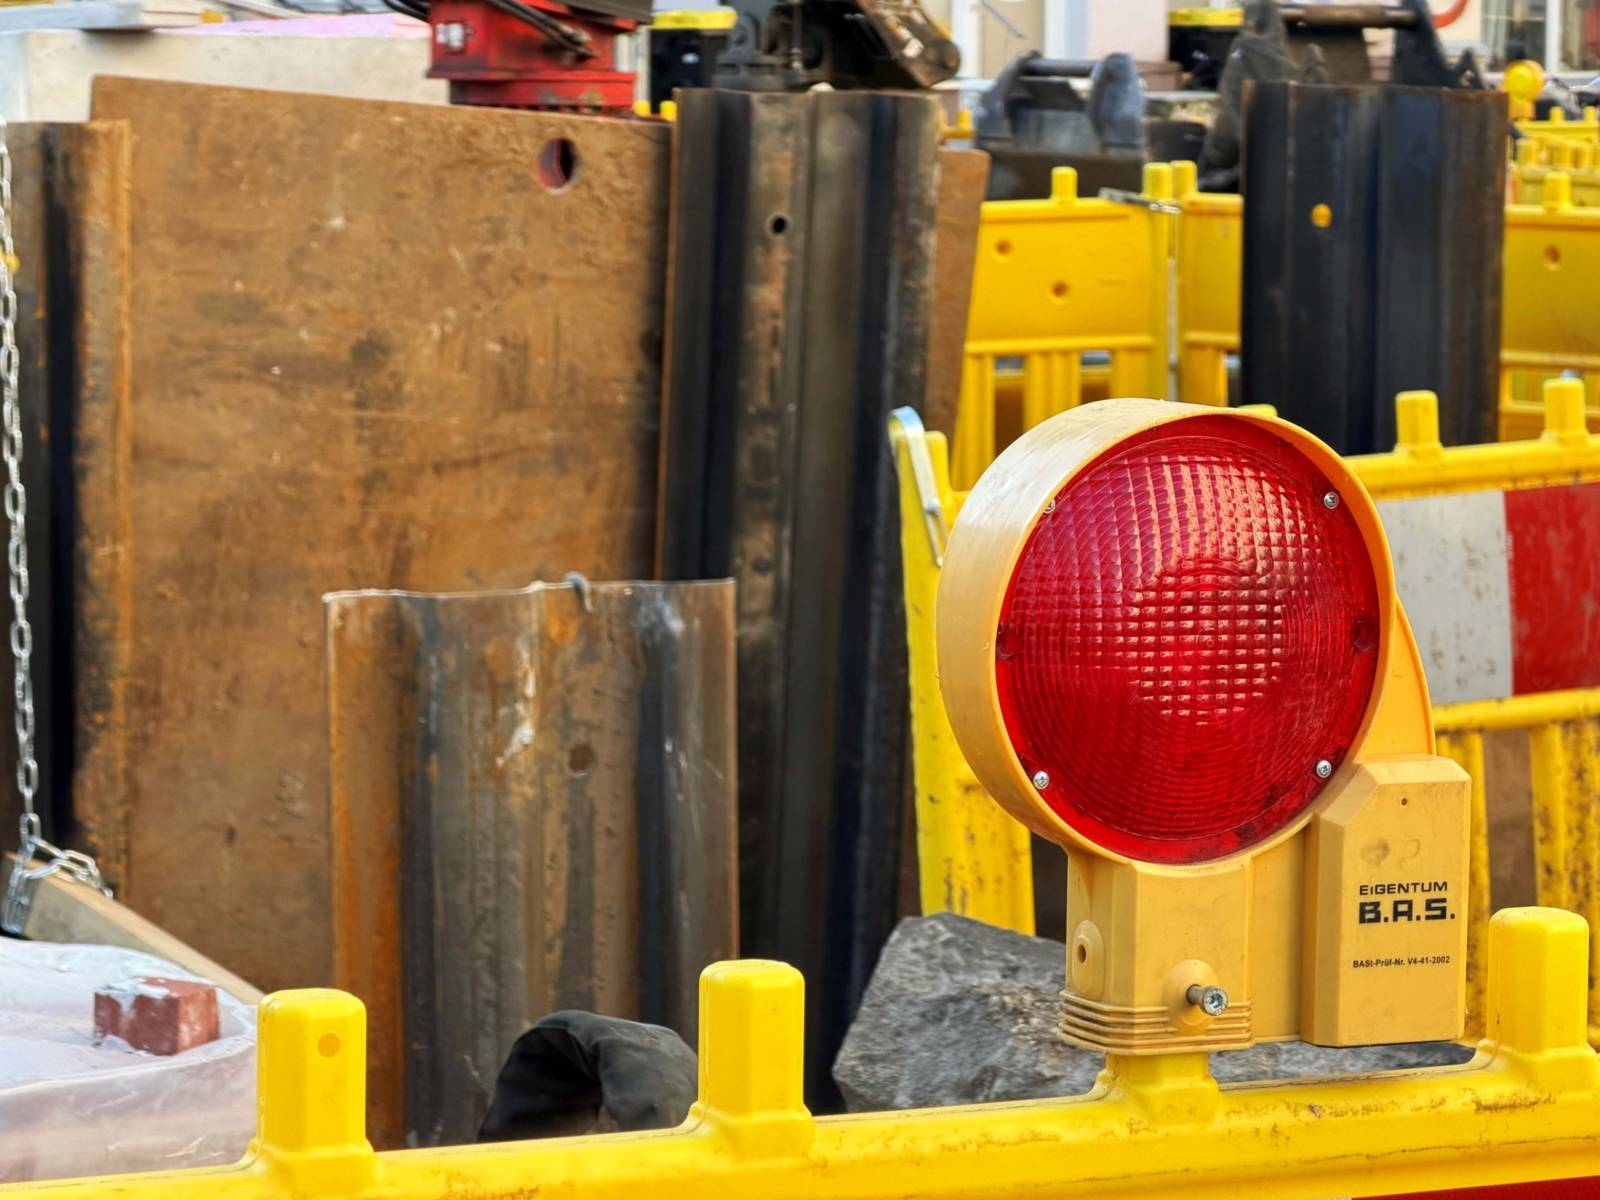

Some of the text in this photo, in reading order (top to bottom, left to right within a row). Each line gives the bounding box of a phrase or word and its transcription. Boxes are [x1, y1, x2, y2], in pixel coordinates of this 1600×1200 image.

[1359, 881, 1448, 896] EIGENTUM
[1359, 898, 1456, 924] B.A.S.
[1353, 955, 1451, 969] BASt-Prüf-Nr. V4-41-2002
